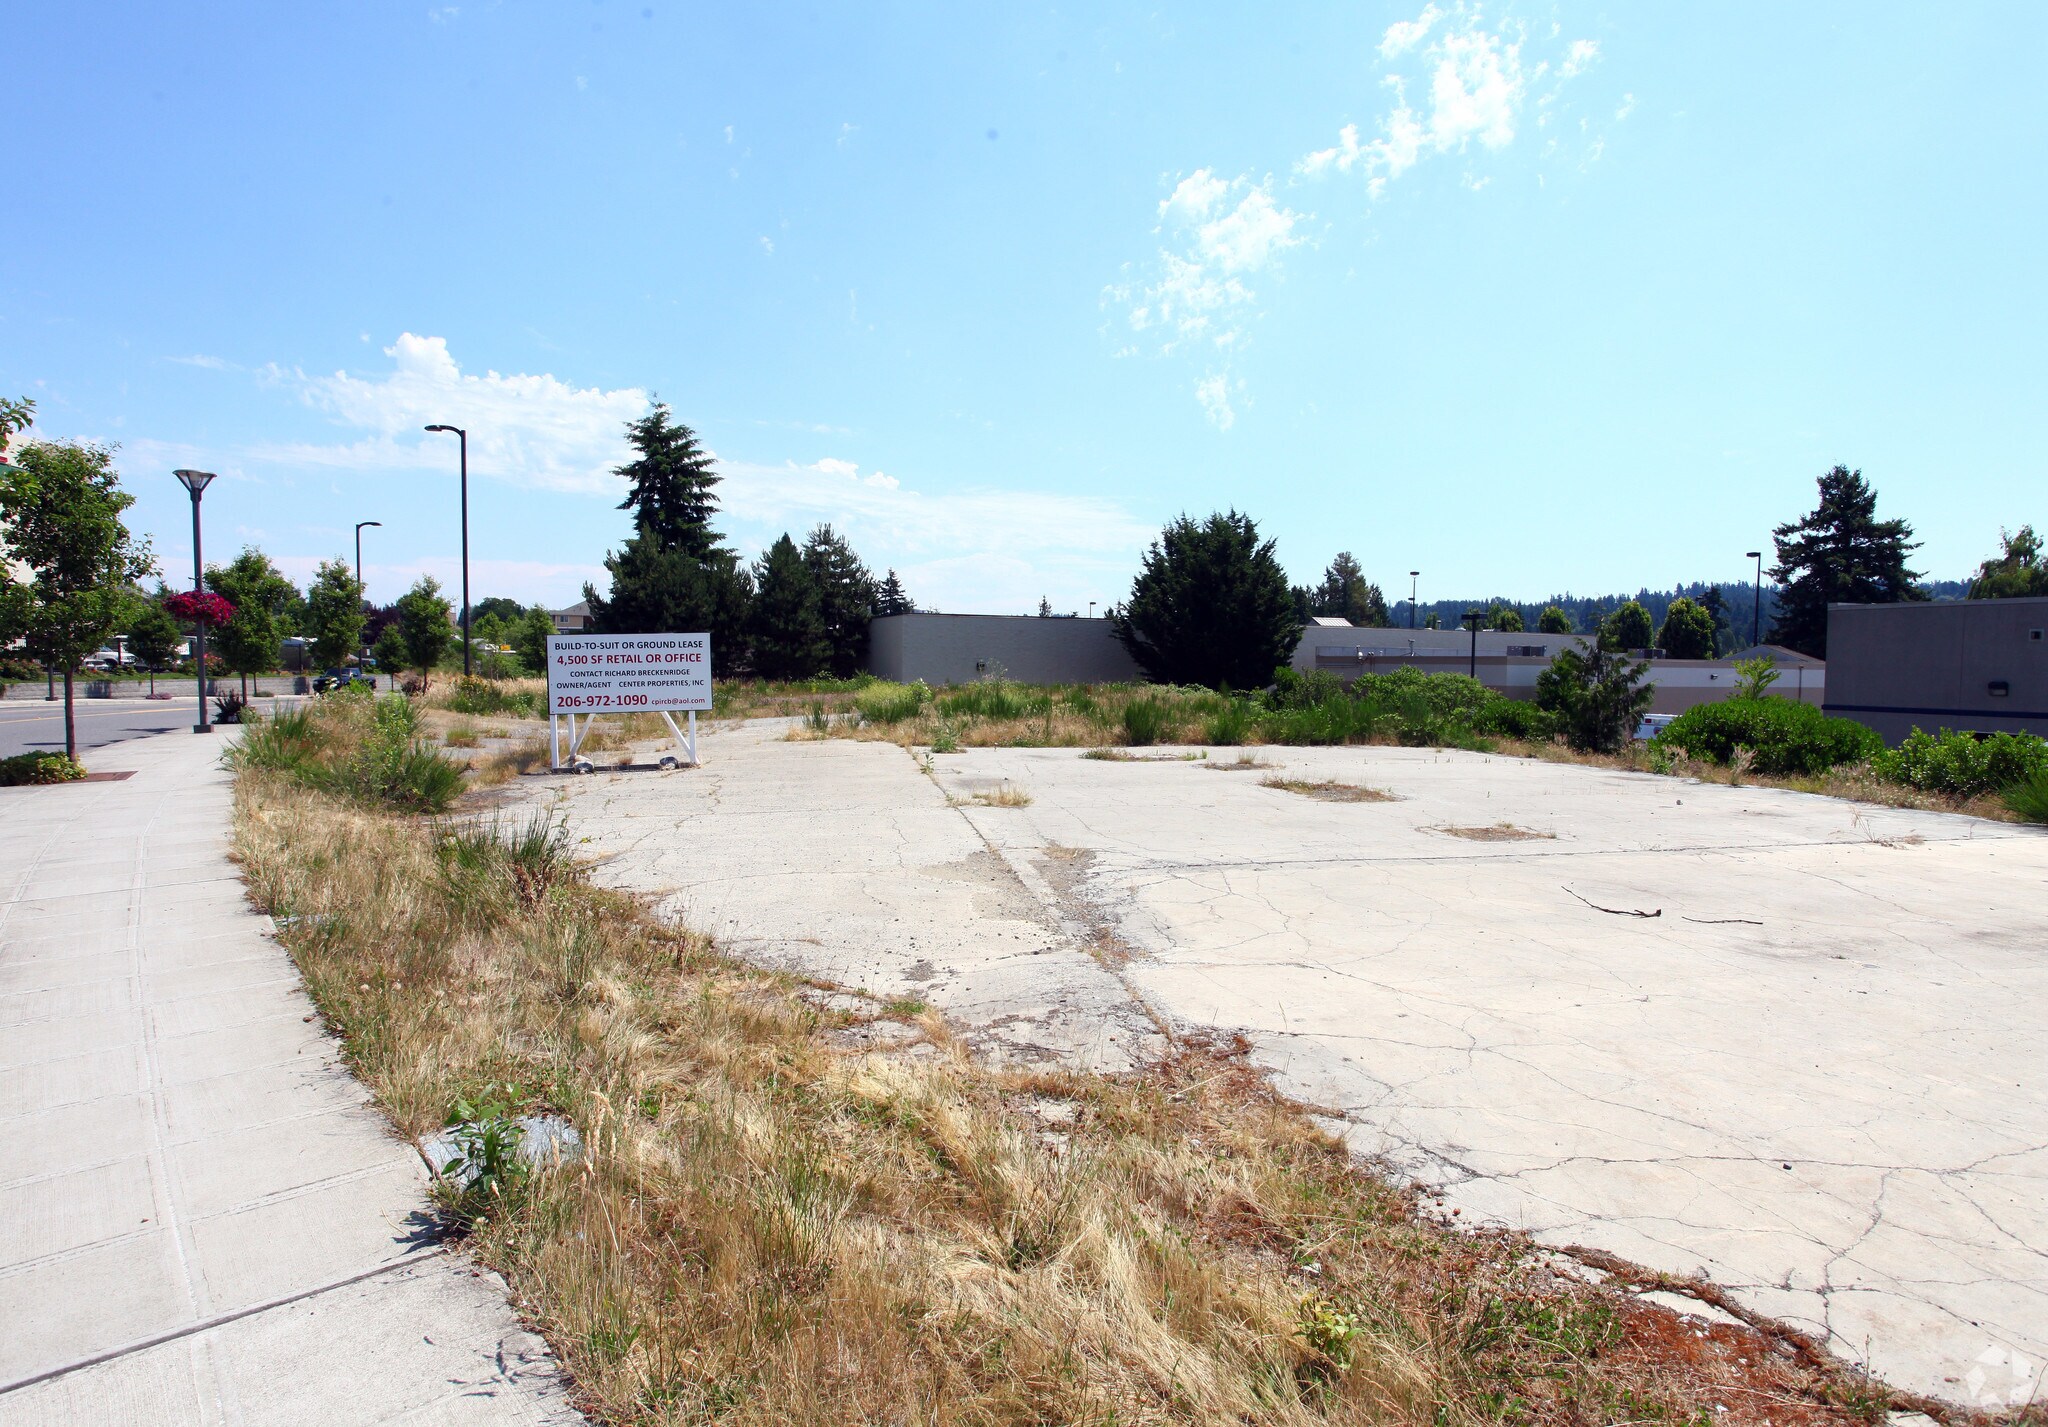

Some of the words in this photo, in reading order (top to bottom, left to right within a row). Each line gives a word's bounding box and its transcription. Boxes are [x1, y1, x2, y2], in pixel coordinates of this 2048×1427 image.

[555, 641, 619, 650] BUILD-TO-SUIT
[622, 641, 635, 650] OR
[637, 641, 676, 649] GROUND
[678, 640, 703, 648] LEASE
[557, 655, 588, 666] 4,500
[591, 654, 603, 664] SF
[606, 654, 643, 664] RETAIL
[645, 653, 662, 663] OR
[664, 653, 701, 663] OFFICE
[570, 670, 603, 678] CONTACT
[556, 681, 612, 689] OWNER/AGENT
[618, 680, 646, 688] CENTER
[557, 694, 648, 708] 206-972-1090
